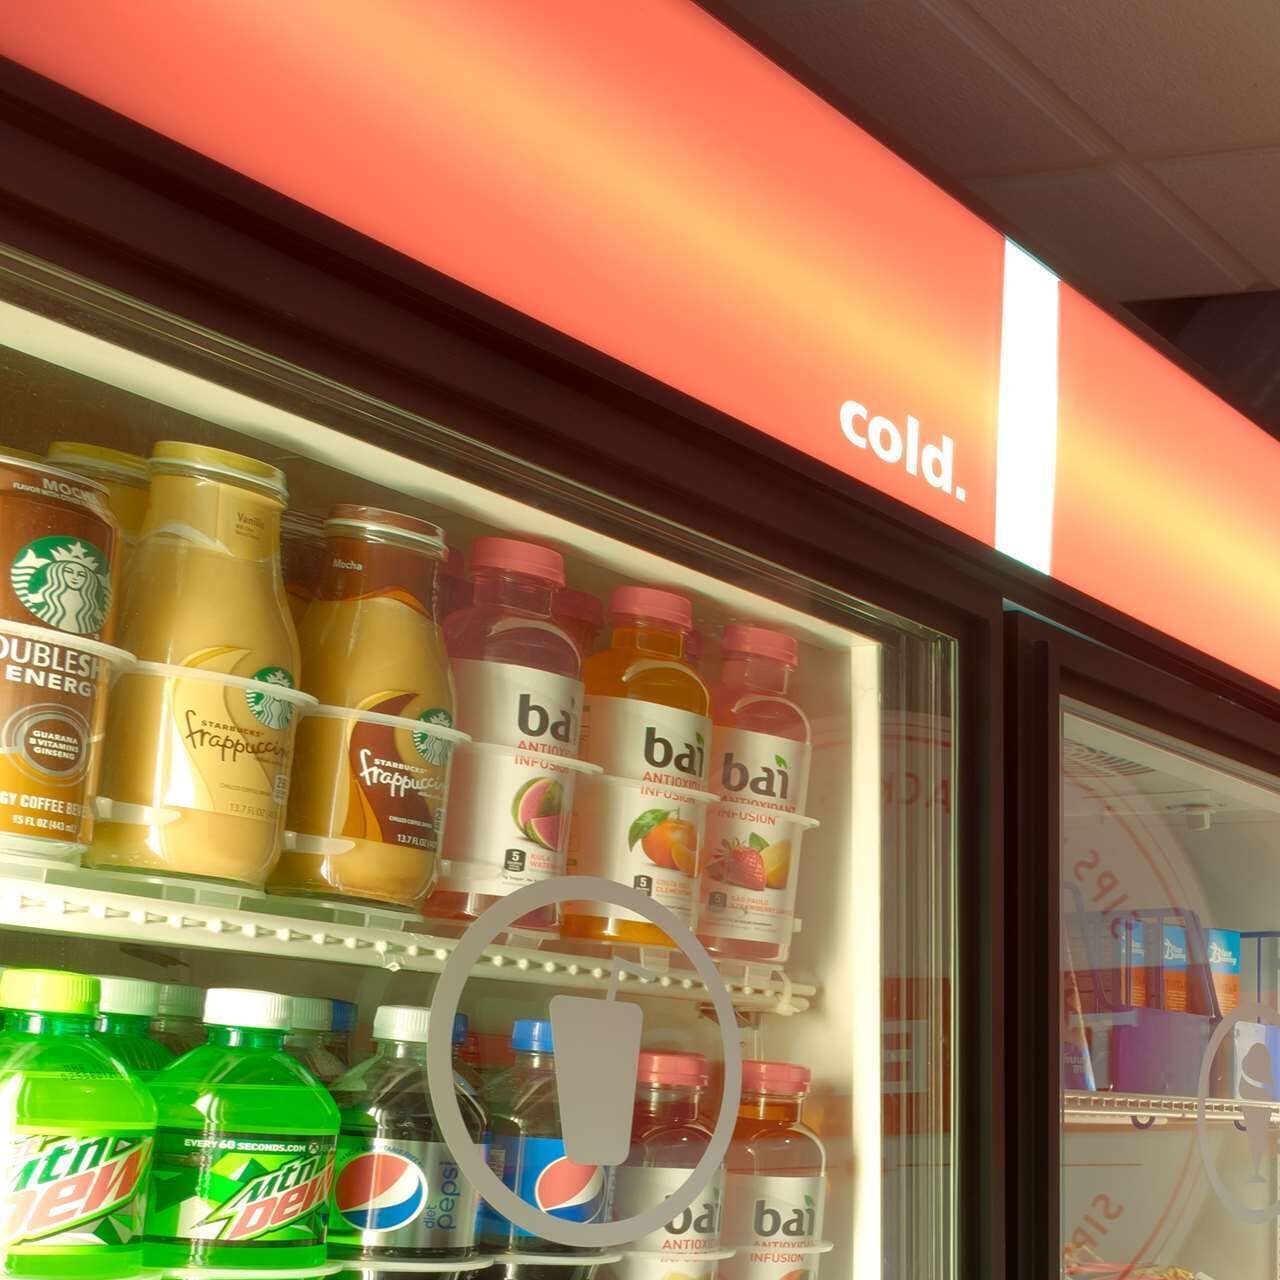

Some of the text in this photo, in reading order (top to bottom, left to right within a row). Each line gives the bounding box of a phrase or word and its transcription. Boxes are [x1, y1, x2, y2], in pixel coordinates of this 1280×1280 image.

[839, 399, 966, 502] cold.
[331, 558, 364, 572] Mocha
[33, 745, 76, 761] GINSENG
[643, 726, 706, 778] bai
[721, 752, 790, 800] bai
[20, 793, 65, 815] COFFEE
[717, 808, 777, 825] INFUSION
[183, 1138, 218, 1150] EVERY
[218, 1138, 236, 1150] 60
[236, 1141, 307, 1154] SECONDS.COM
[436, 1161, 460, 1230] pepsi
[423, 1204, 437, 1230] diet
[754, 1194, 816, 1238] bai
[750, 1252, 805, 1264] INFUSION
